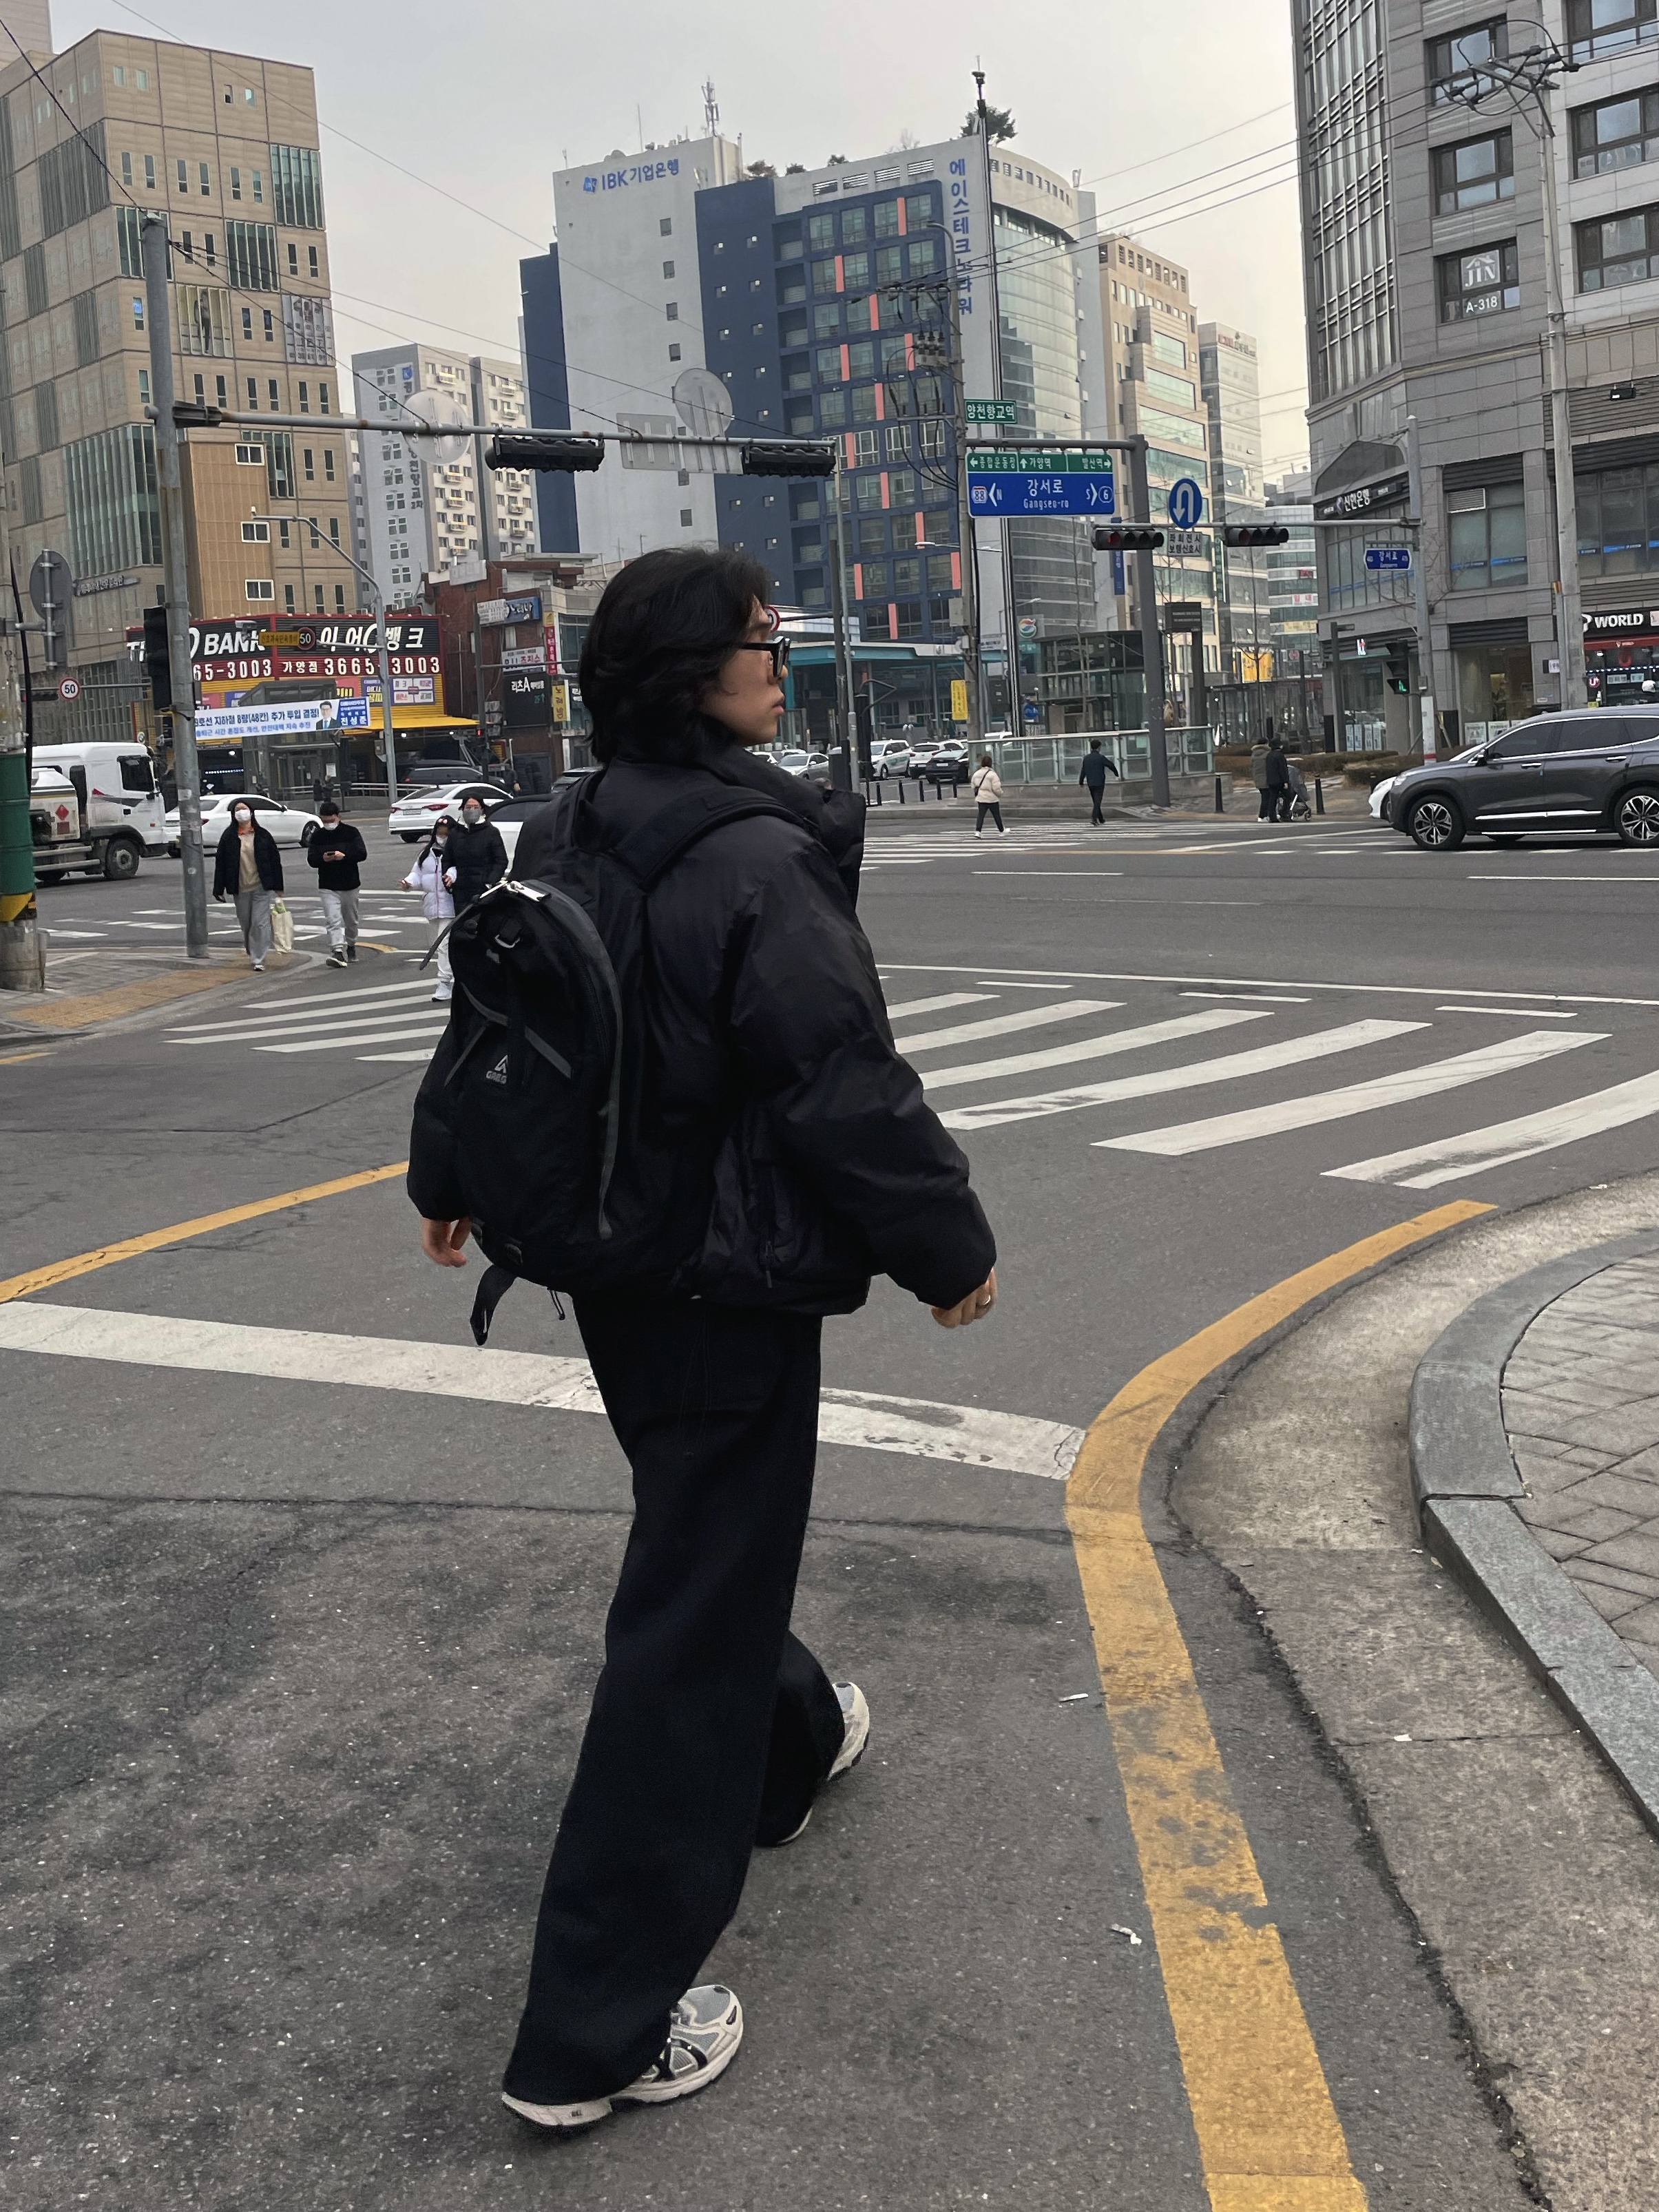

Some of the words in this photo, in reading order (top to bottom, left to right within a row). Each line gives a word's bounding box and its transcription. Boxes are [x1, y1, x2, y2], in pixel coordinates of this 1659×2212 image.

[949, 158, 972, 315] 에이스테크노타워
[1465, 296, 1497, 313] A-318
[967, 404, 1014, 420] 양천향교역
[1030, 457, 1051, 469] 가양역
[1082, 457, 1103, 470] 발산역
[974, 490, 985, 500] 88
[997, 489, 1003, 500] N
[1027, 479, 1063, 497] 강서로
[1023, 498, 1069, 510] Gangseo-ro
[1594, 613, 1644, 629] WORLD
[299, 633, 311, 644] 50
[282, 661, 317, 674] 가양점
[324, 657, 439, 676] 36653003
[64, 685, 76, 693] 50
[214, 715, 235, 725] 지하철
[271, 711, 285, 721] 추가
[287, 710, 301, 720] 투입
[303, 708, 320, 718] 결정!
